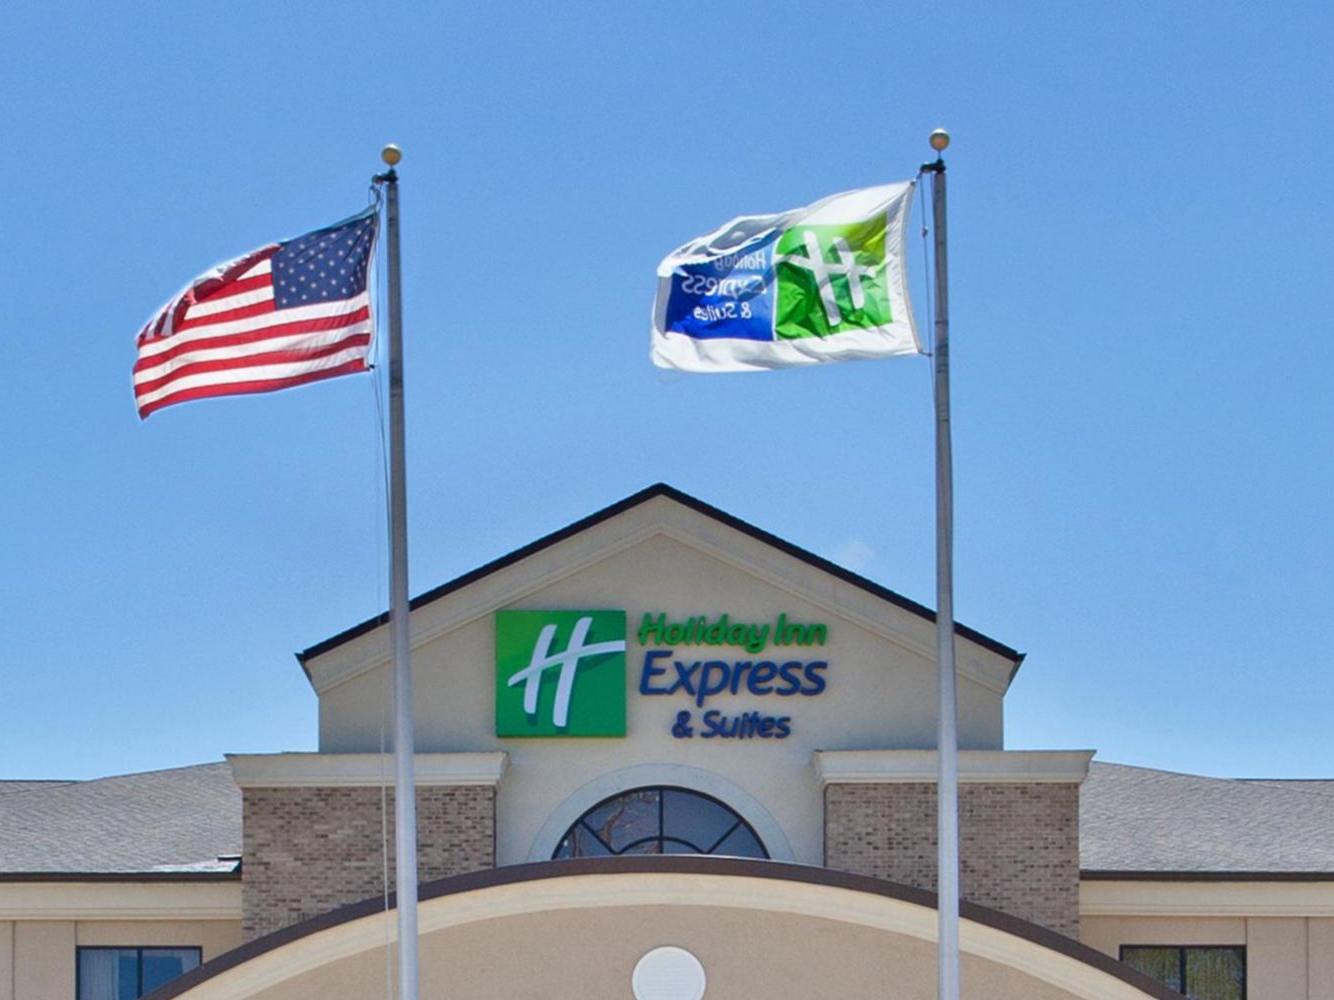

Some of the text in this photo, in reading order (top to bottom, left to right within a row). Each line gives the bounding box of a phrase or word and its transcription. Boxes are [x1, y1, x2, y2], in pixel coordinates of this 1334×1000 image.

[638, 612, 828, 654] Holiday Inn
[639, 650, 828, 708] Express
[671, 710, 791, 740] & Suites
